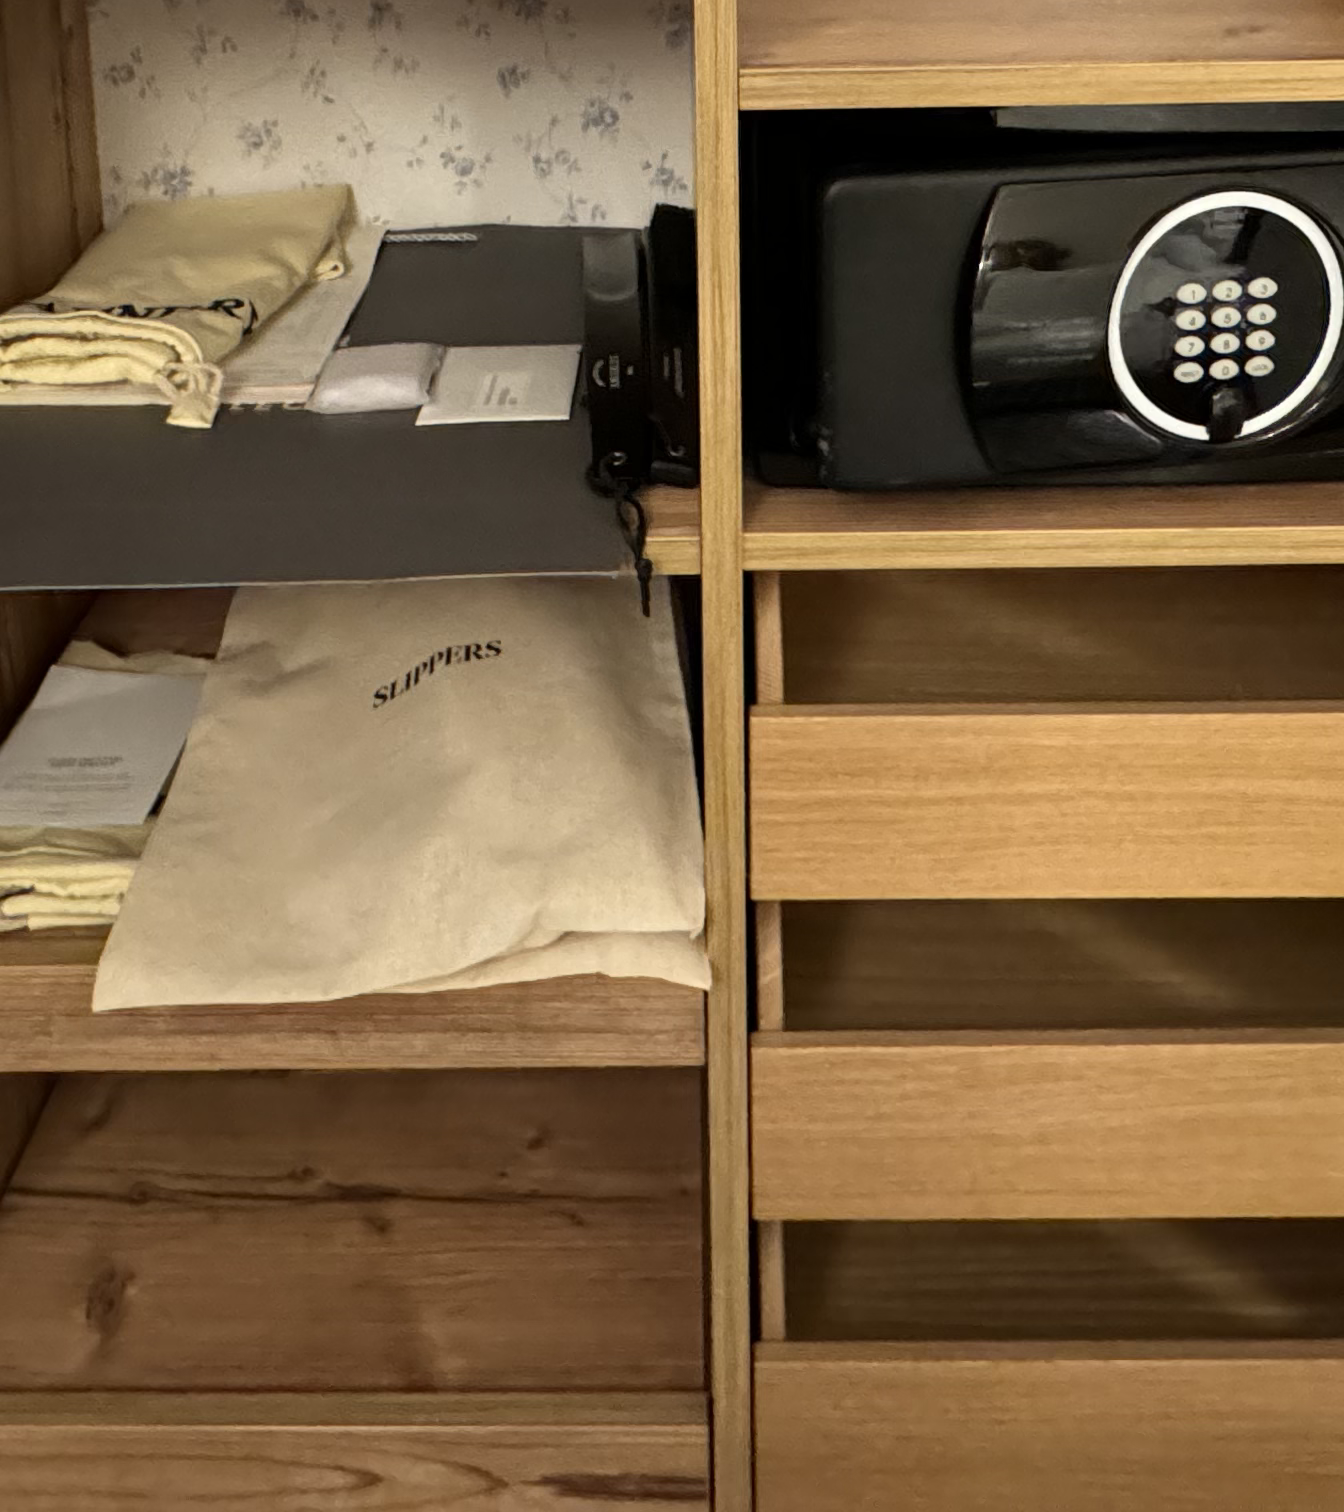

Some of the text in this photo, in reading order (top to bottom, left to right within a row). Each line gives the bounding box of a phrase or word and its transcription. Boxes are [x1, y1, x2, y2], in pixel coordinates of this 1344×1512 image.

[1224, 287, 1233, 299] 2
[1223, 313, 1233, 324] 5
[1223, 339, 1231, 351] 8
[1221, 365, 1231, 377] 0
[372, 639, 503, 709] SLIPPERS
